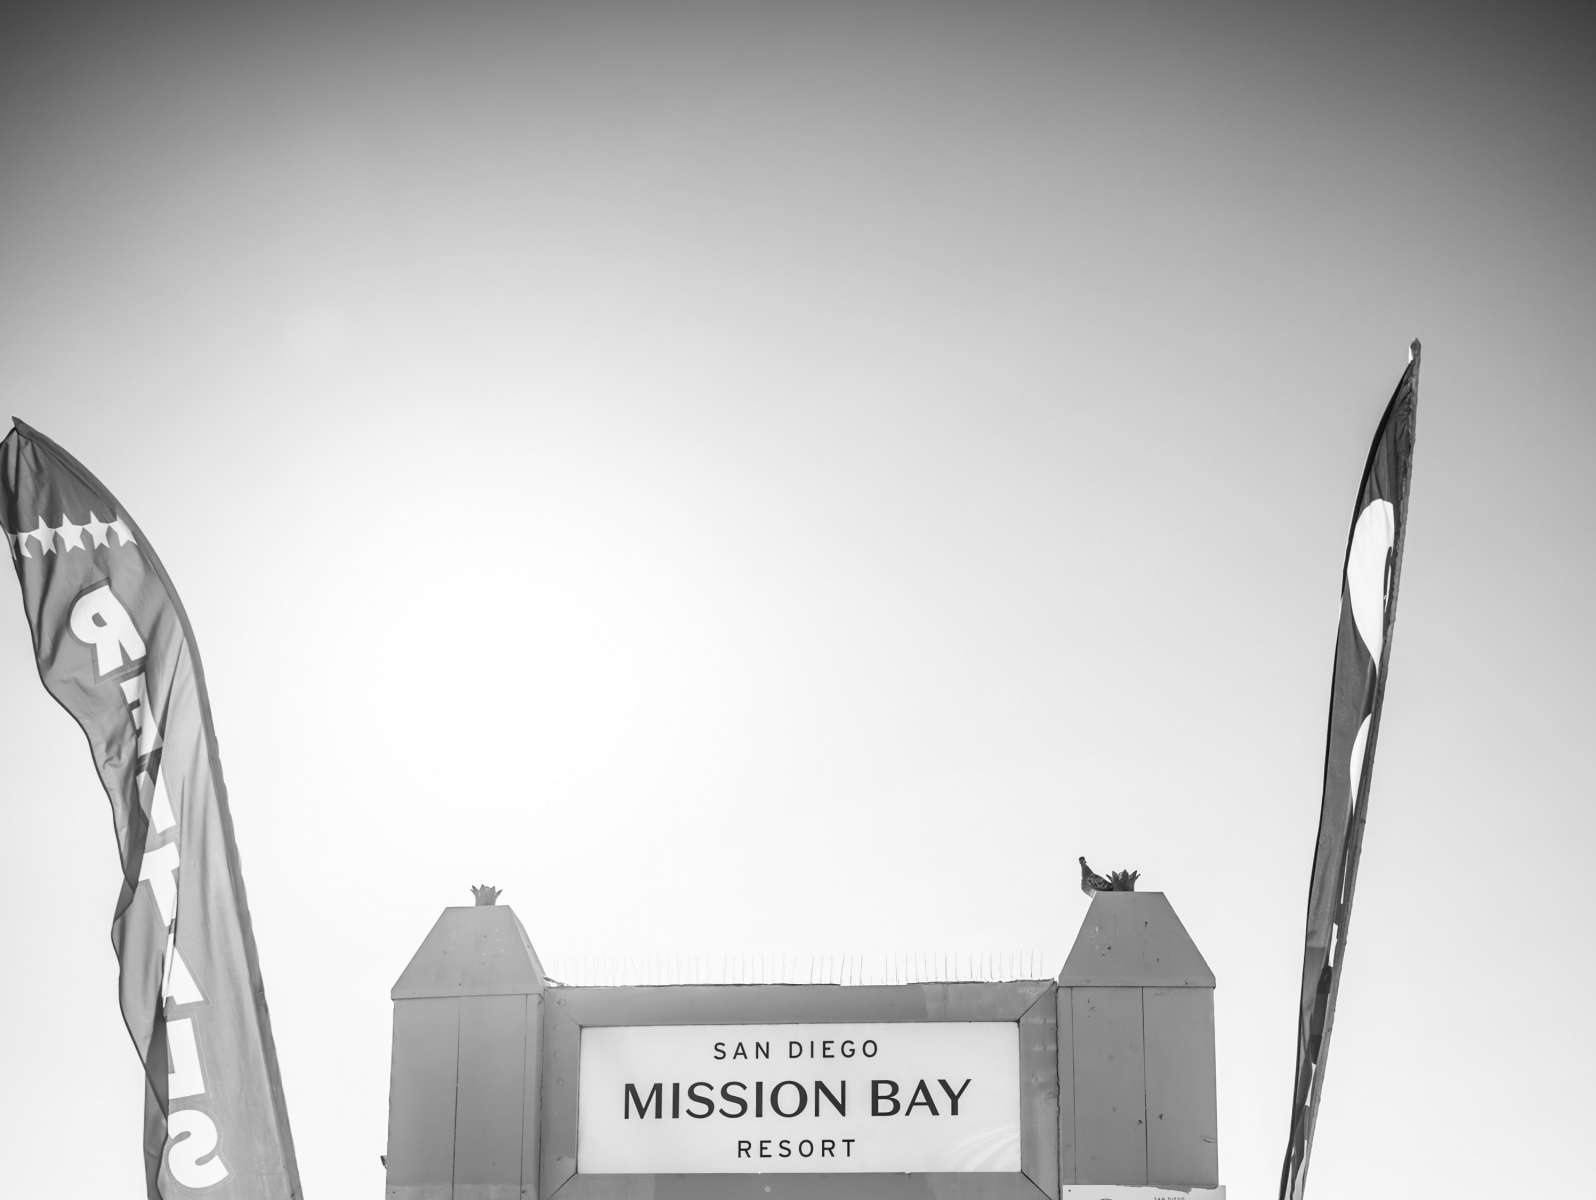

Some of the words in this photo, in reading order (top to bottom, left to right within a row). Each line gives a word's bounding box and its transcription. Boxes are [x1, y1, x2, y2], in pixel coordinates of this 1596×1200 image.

[713, 1041, 771, 1061] SAN
[788, 1039, 879, 1059] DIEGO
[623, 1080, 847, 1120] MISSION
[870, 1078, 972, 1117] BAY
[737, 1139, 856, 1159] RESORT
